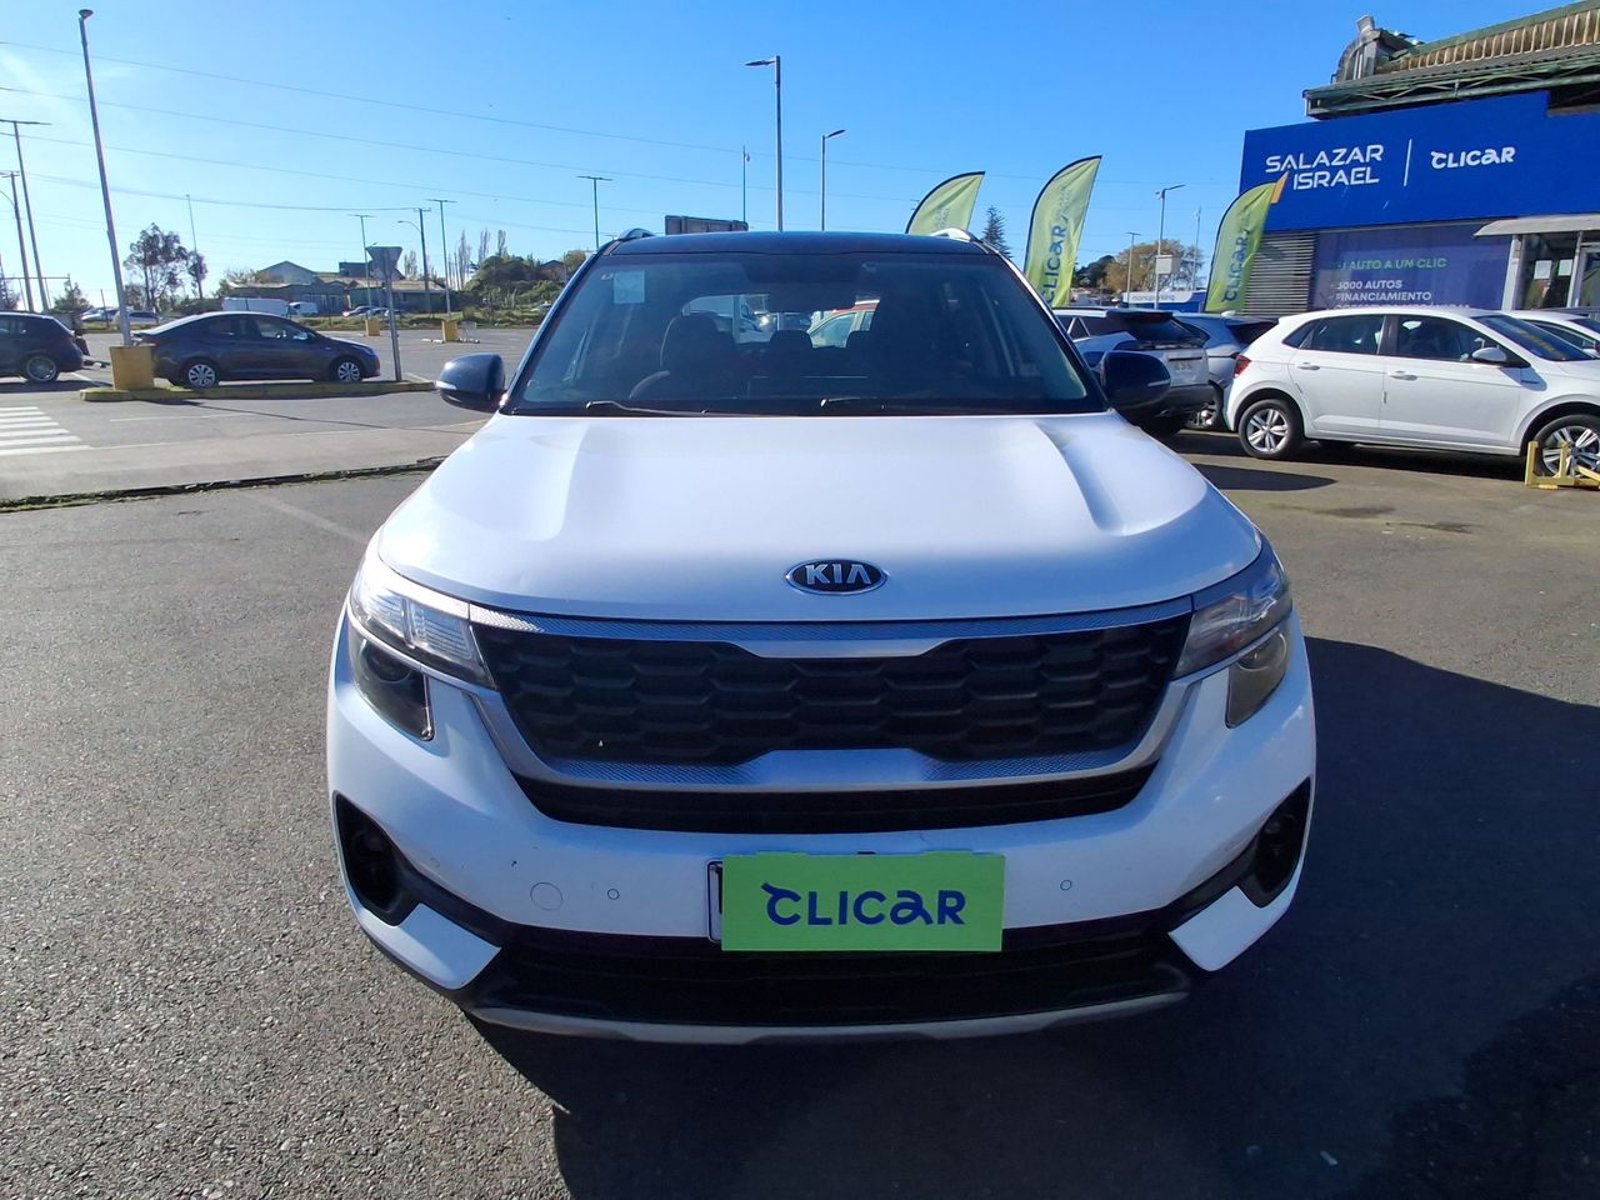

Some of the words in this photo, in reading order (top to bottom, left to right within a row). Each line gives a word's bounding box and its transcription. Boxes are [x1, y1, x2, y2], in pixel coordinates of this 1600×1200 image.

[1265, 144, 1385, 173] SALAZAR
[1293, 166, 1380, 190] ISRAEL
[1349, 260, 1381, 271] AUTO
[1384, 260, 1393, 270] A
[1395, 259, 1414, 270] UN
[1416, 257, 1447, 269] CLIC
[1364, 279, 1403, 290] AUTOS
[1335, 291, 1432, 302] FINANCIAMIENTO
[804, 562, 872, 585] KIA
